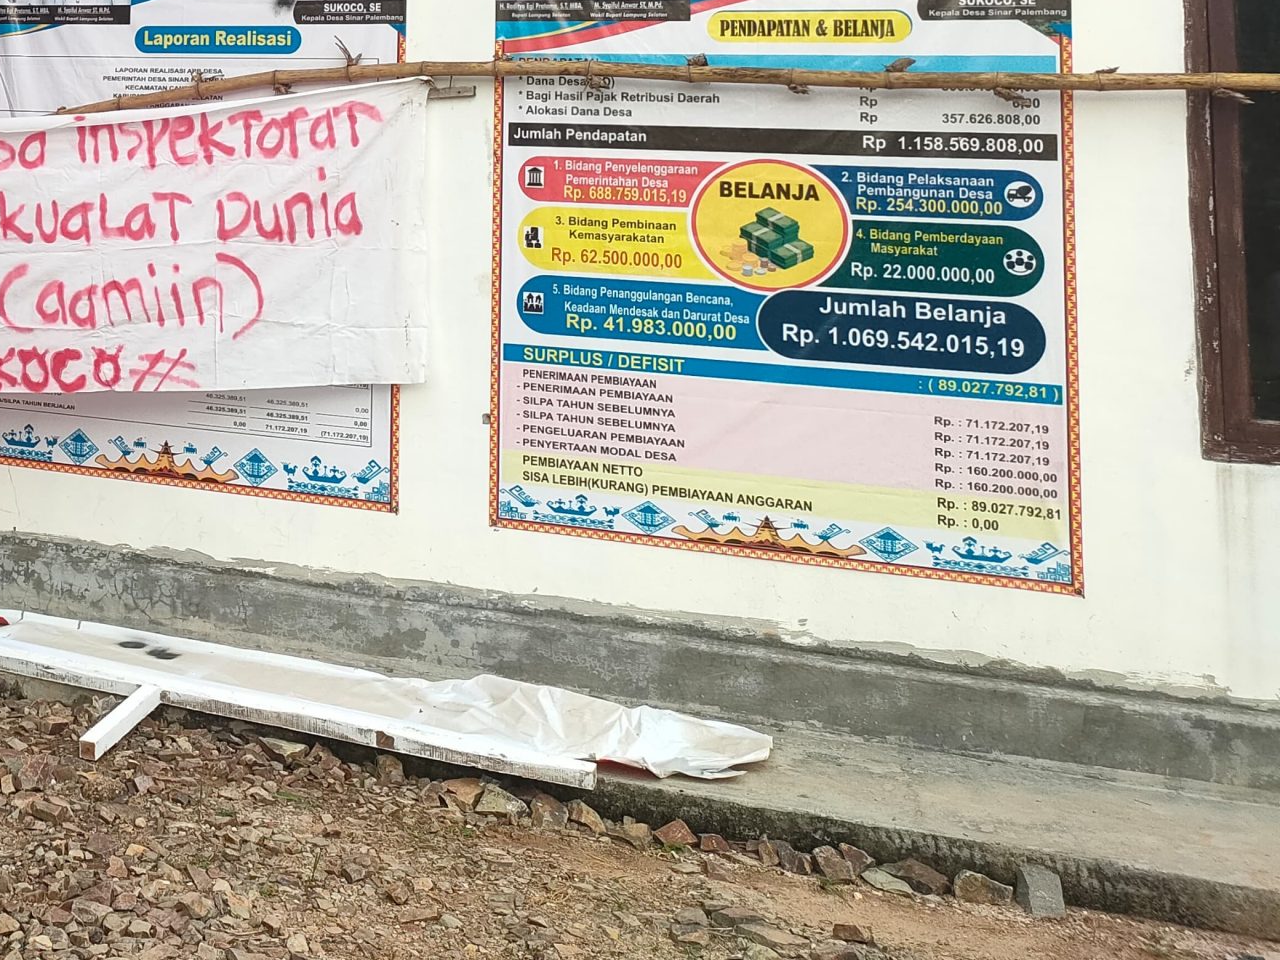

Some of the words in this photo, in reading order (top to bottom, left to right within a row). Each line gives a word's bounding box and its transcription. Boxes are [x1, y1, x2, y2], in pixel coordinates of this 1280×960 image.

[324, 3, 366, 13] SUKOCO,
[369, 3, 382, 12] SE
[928, 9, 960, 18] Kepala
[962, 8, 986, 16] Desa
[988, 8, 1012, 16] Sinar
[1014, 8, 1068, 17] Palembang
[365, 14, 404, 22] Palembang
[720, 20, 811, 37] PENDAPATAN
[816, 20, 828, 36] &
[833, 19, 895, 38] BELANJA
[144, 31, 210, 49] Laporan
[215, 30, 292, 46] Realisasi
[526, 106, 568, 116] Alokasi
[571, 106, 600, 116] Dana
[603, 106, 633, 118] Desa
[860, 112, 878, 124] Rp
[942, 114, 1040, 126] 357.626.808,00
[513, 127, 562, 140] Jumlah
[566, 128, 647, 144] Pendapatan
[862, 135, 886, 151] Rp
[898, 136, 1044, 154] 1.158.569.808,00
[553, 160, 562, 171] 1.
[565, 160, 602, 174] Bidang
[604, 161, 698, 178] Penyelenggaraan
[566, 174, 638, 188] Pemerintahan
[641, 177, 669, 188] Desa
[842, 172, 852, 182] 2.
[856, 172, 904, 187] Bidang
[908, 173, 994, 188] Pelaksanaan
[564, 186, 585, 202] Rp.
[589, 186, 687, 204] 688.759.015,19
[720, 181, 820, 202] BELANJA
[857, 184, 956, 200] Pembangunan
[958, 188, 993, 200] Desa
[856, 197, 882, 213] Rp.
[886, 198, 1003, 217] 254.300.000,00
[555, 216, 565, 226] 3.
[568, 216, 608, 230] Bidang
[612, 218, 676, 231] Pembinaan
[568, 230, 664, 244] Kemasyarakatan
[856, 230, 866, 240] 4.
[870, 229, 911, 244] Bidang
[914, 230, 1004, 248] Pemberdayaan
[551, 248, 576, 266] Rp.
[580, 250, 682, 270] 62.500.000,00
[870, 242, 938, 258] Masyarakat
[850, 262, 878, 280] Rp.
[882, 264, 995, 285] 22.000.000,00
[552, 284, 561, 294] 5.
[564, 284, 598, 299] Bidang
[600, 288, 683, 304] Penanggulangan
[686, 293, 734, 308] Bencana,
[564, 301, 606, 314] Keadaan
[609, 304, 659, 318] Mendesak
[661, 308, 680, 318] dan
[682, 309, 722, 322] Darurat
[724, 312, 750, 324] Desa
[819, 297, 906, 319] Jumlah
[915, 301, 1007, 328] Belanja
[566, 313, 597, 332] Rp.
[603, 316, 736, 341] 41.983.000,00
[782, 323, 820, 347] Rp.
[828, 326, 1025, 358] 1.069.542.015,19
[524, 348, 604, 366] SURPLUS
[606, 350, 614, 367] /
[618, 354, 686, 372] DEFISIT
[938, 379, 1047, 400] 89.027.792,81
[42, 401, 75, 410] BERJALAN
[522, 455, 599, 473] PEMBIAYAAN
[602, 464, 644, 478] NETTO
[522, 471, 550, 484] SISA
[552, 473, 648, 497] LEBIH(KURANG)
[652, 484, 734, 504] PEMBIAYAAN
[736, 494, 813, 512] ANGGARAN
